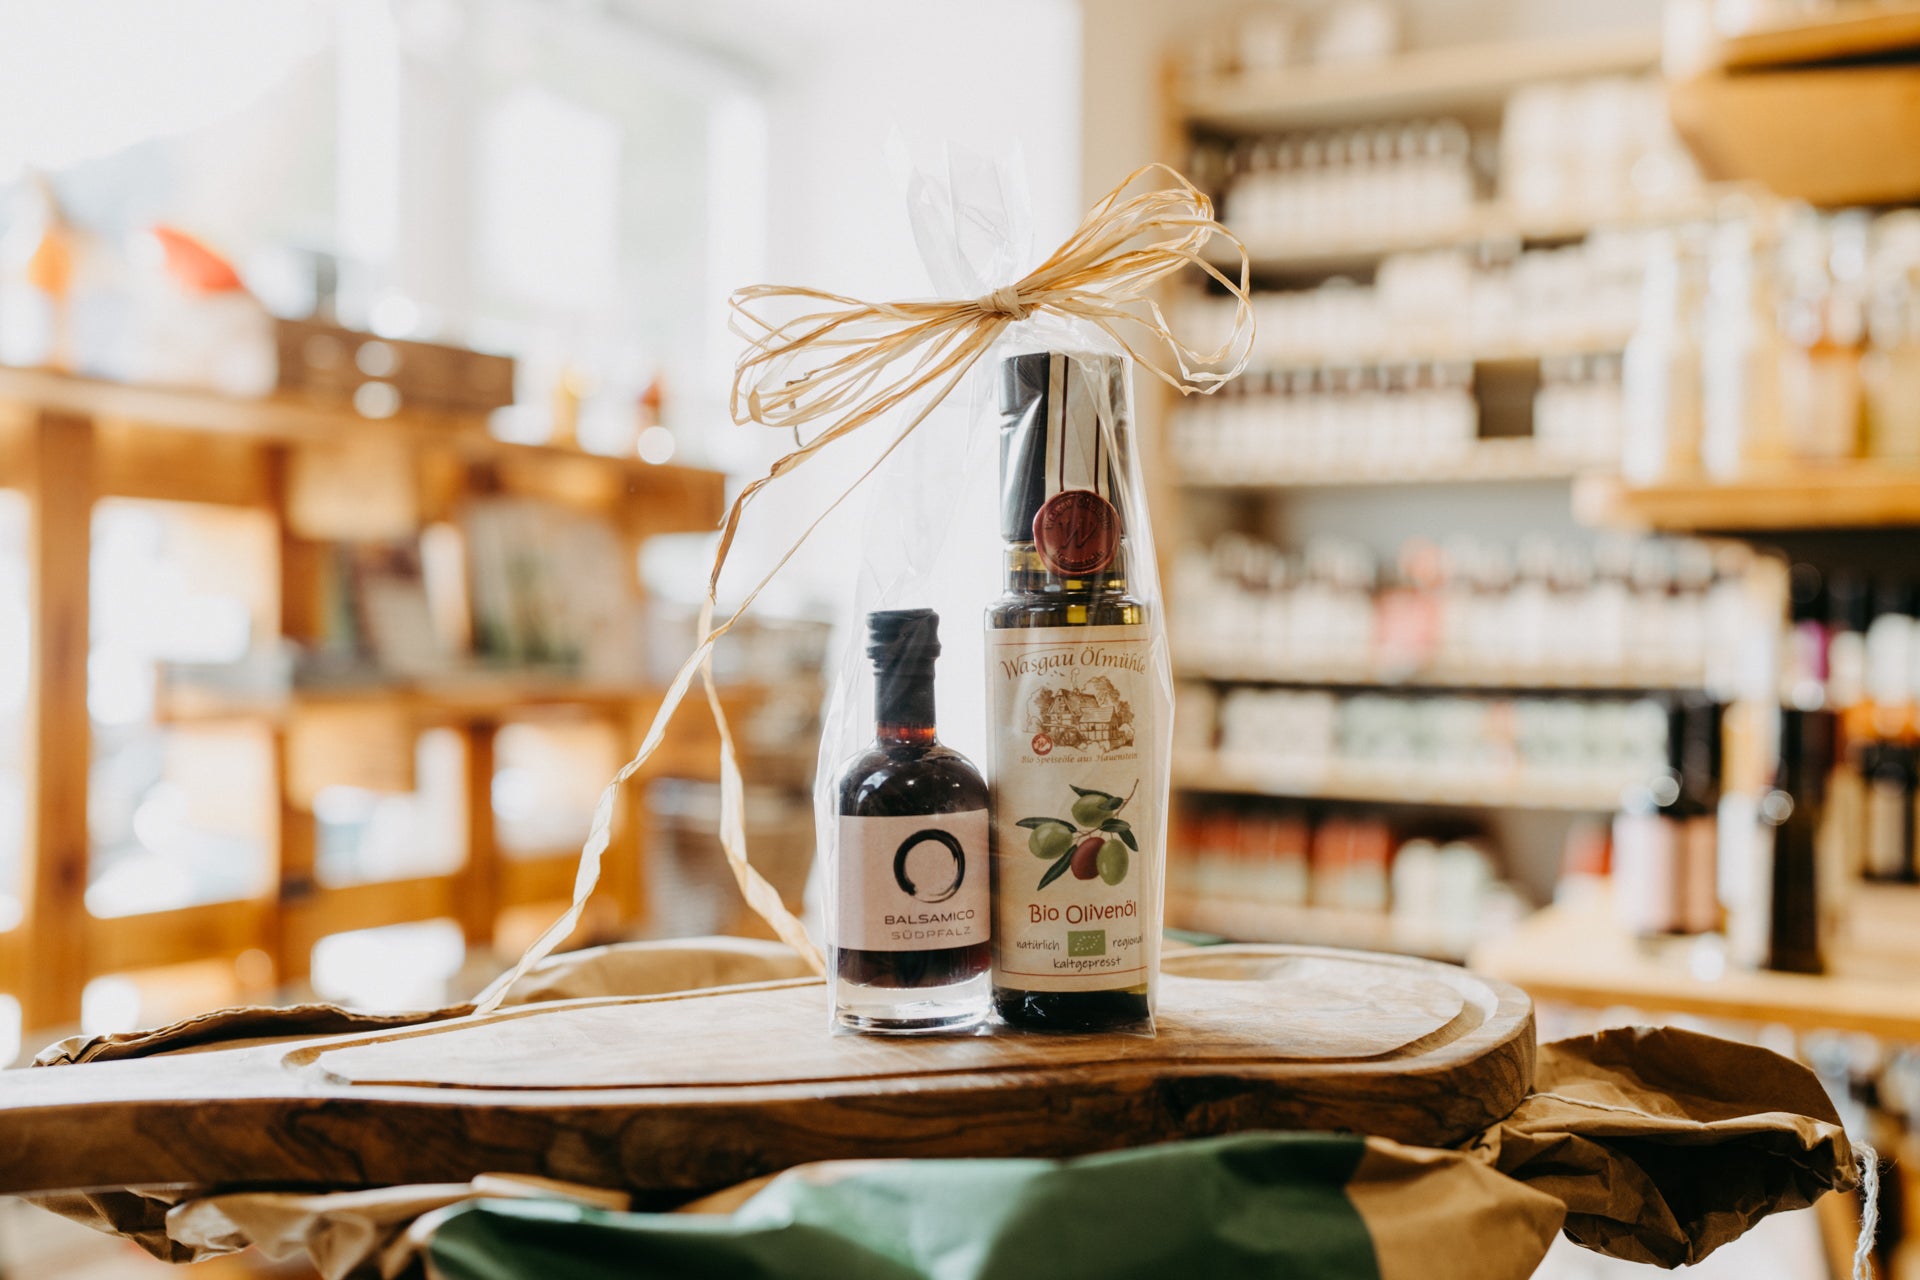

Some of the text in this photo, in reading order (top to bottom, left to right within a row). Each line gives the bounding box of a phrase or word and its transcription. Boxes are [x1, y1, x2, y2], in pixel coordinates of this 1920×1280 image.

[1001, 647, 1146, 681] Wasgau Ölmühle
[884, 909, 975, 925] BALSAMICO
[1028, 900, 1137, 924] Bio Olivenöl
[891, 926, 972, 941] SÜDPFALZ
[1016, 936, 1060, 950] natürlich
[1053, 956, 1122, 972] kaltgepresst
